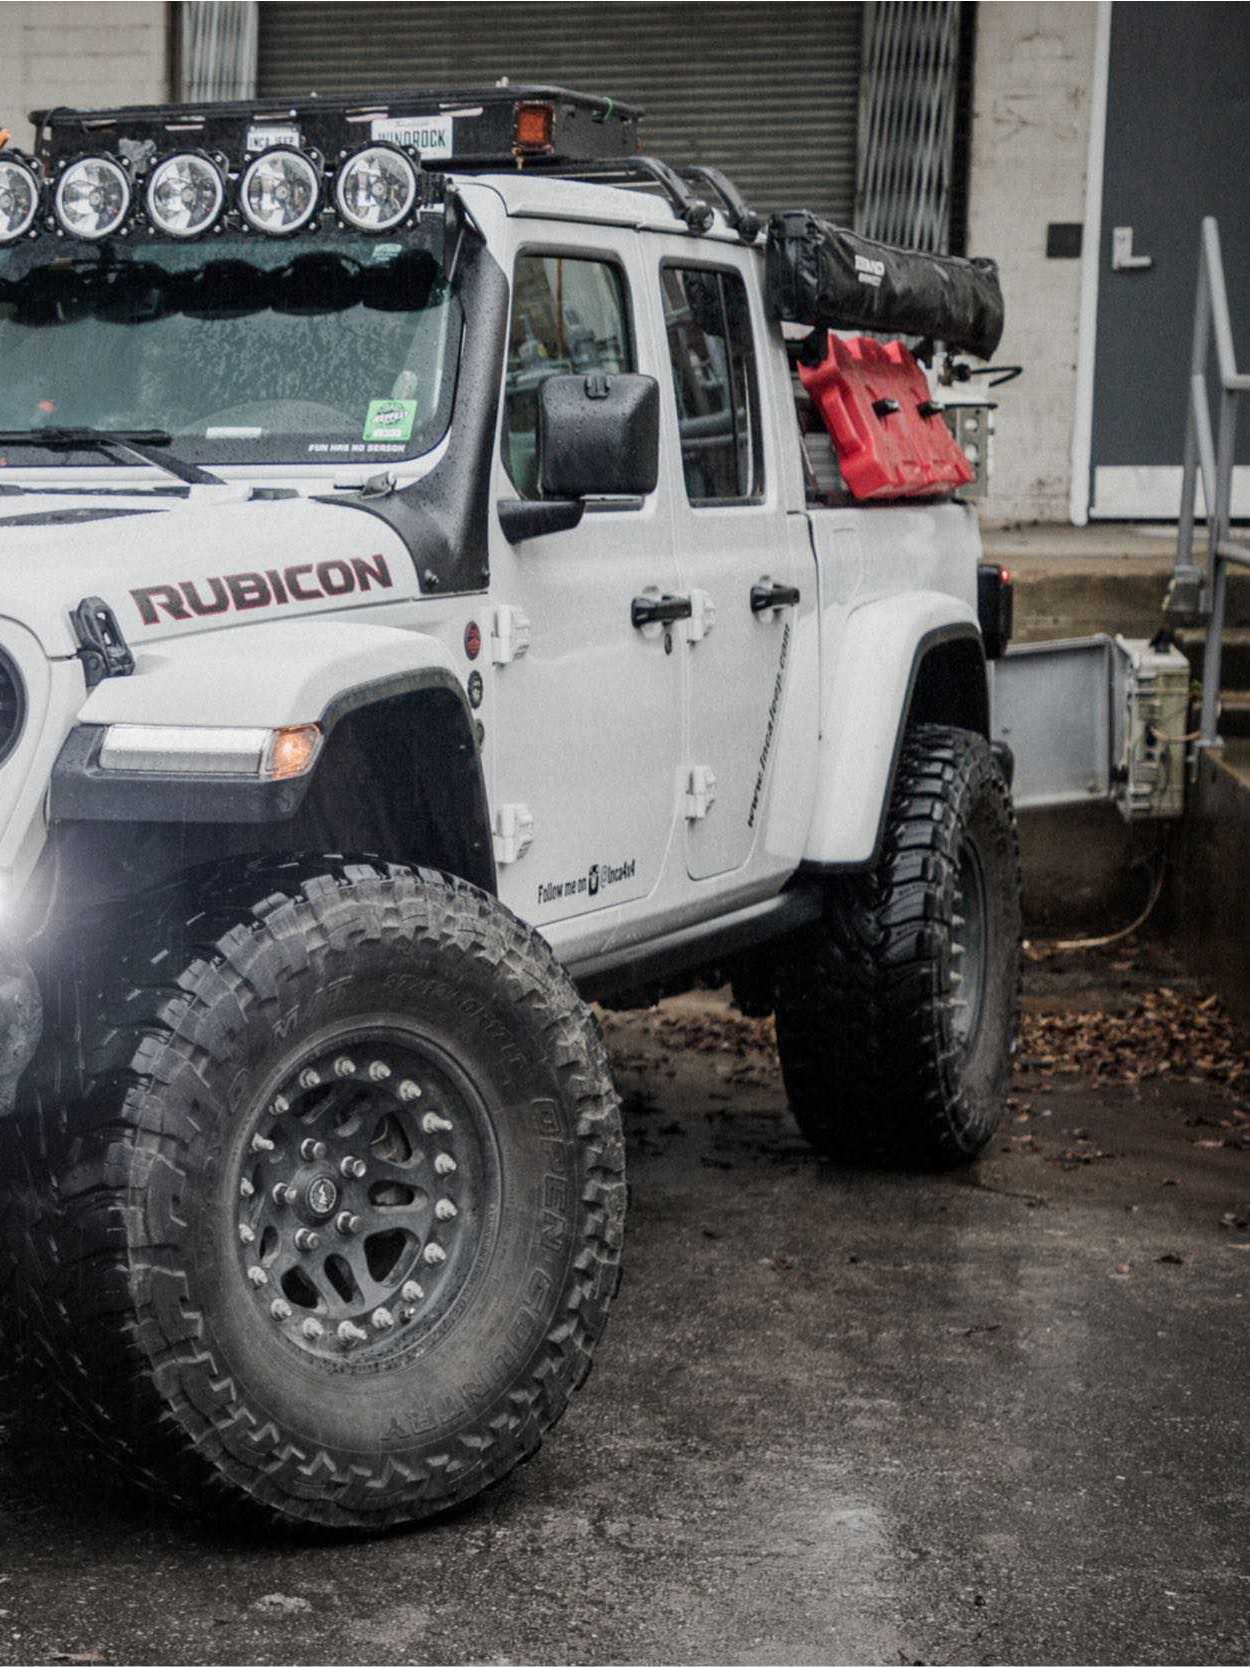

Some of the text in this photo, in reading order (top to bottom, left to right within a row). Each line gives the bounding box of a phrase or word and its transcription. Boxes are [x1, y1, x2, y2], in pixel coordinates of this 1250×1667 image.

[351, 443, 365, 453] NO
[128, 553, 393, 626] RUBICON
[537, 882, 563, 905] Follow
[564, 880, 576, 897] me
[577, 877, 587, 893] on
